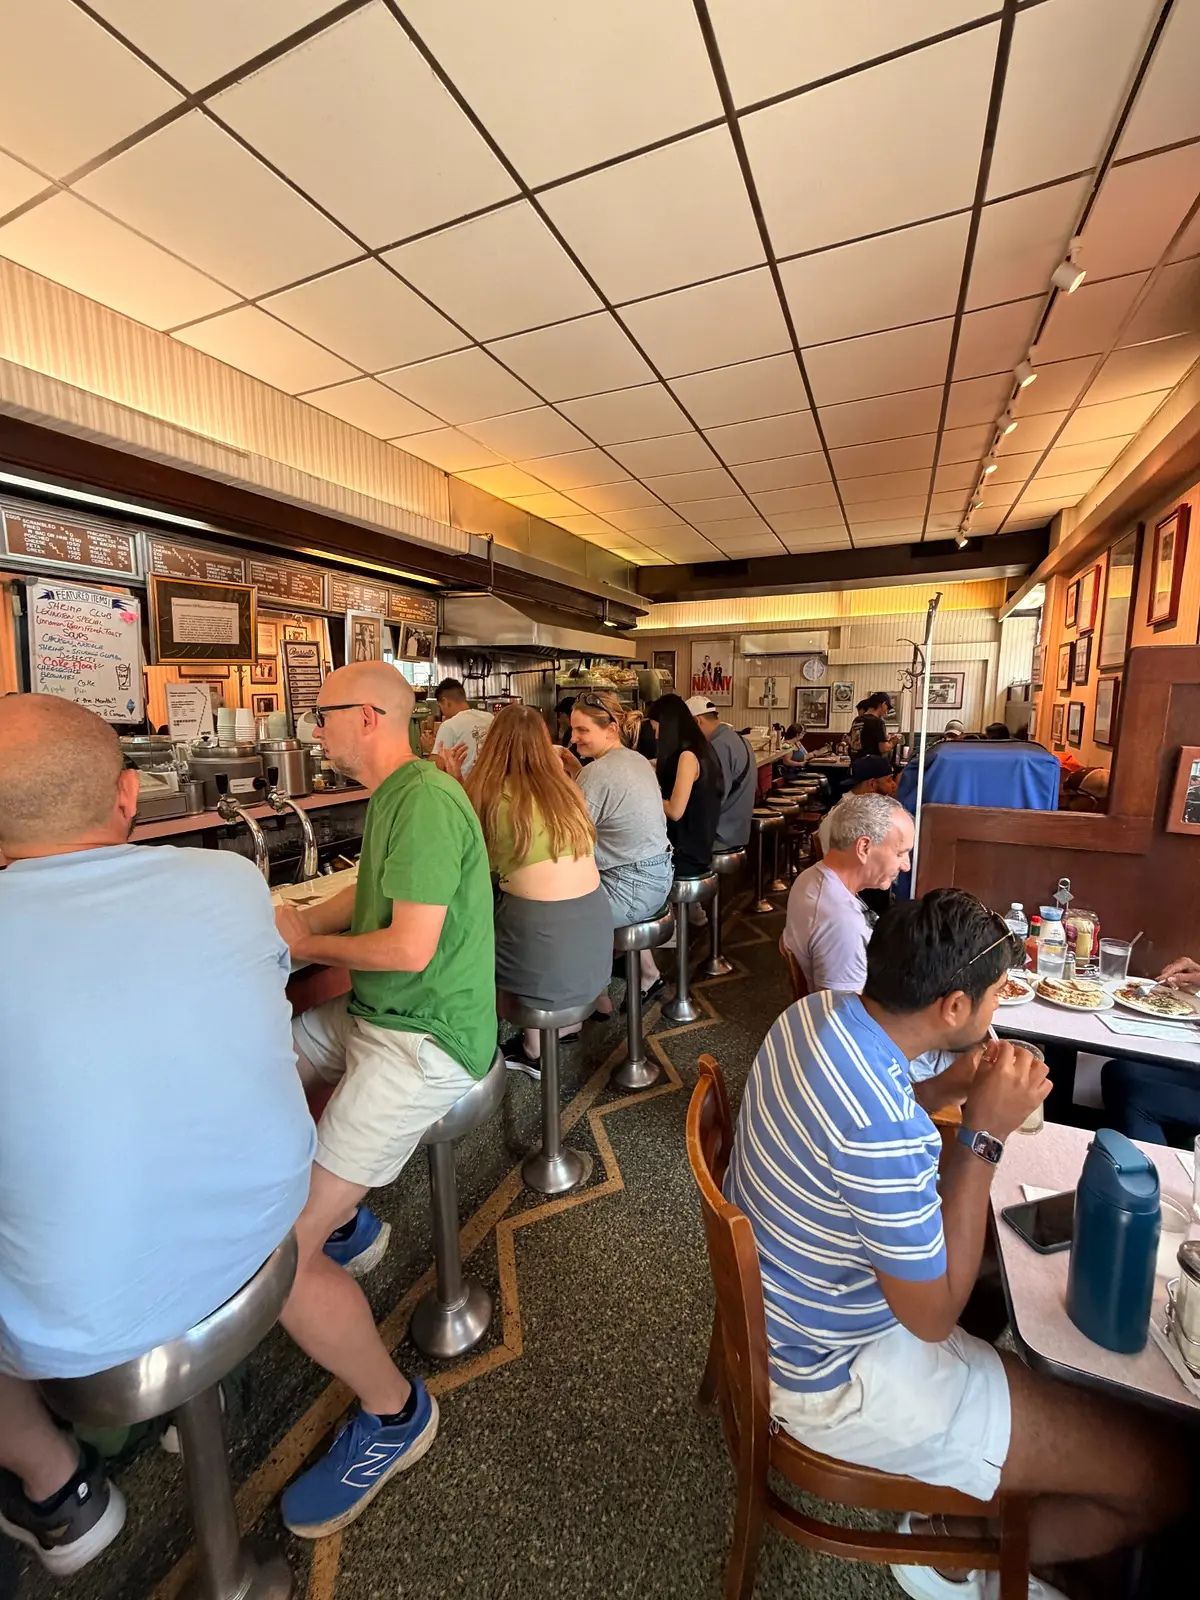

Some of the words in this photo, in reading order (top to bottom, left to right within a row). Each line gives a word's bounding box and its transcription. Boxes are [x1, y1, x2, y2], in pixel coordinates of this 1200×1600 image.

[22, 518, 56, 530] SCRAMBLED
[22, 523, 41, 531] FRIED
[23, 532, 50, 542] POACHED
[86, 530, 112, 539] PANCAKES
[24, 537, 46, 546] CHEESE
[99, 541, 116, 549] BACON
[26, 547, 46, 555] GREEK
[91, 558, 114, 566] CEREALS
[55, 590, 90, 603] FEATURED
[47, 601, 82, 613] SHRIMP
[89, 608, 112, 620] CLUB
[36, 605, 75, 620] LEXINGTON
[76, 615, 103, 626] SPECIAL
[42, 633, 74, 645] CHICKEN
[38, 644, 65, 652] SHRIMP
[40, 671, 75, 680] BROWNIES
[692, 675, 733, 691] NANNY
